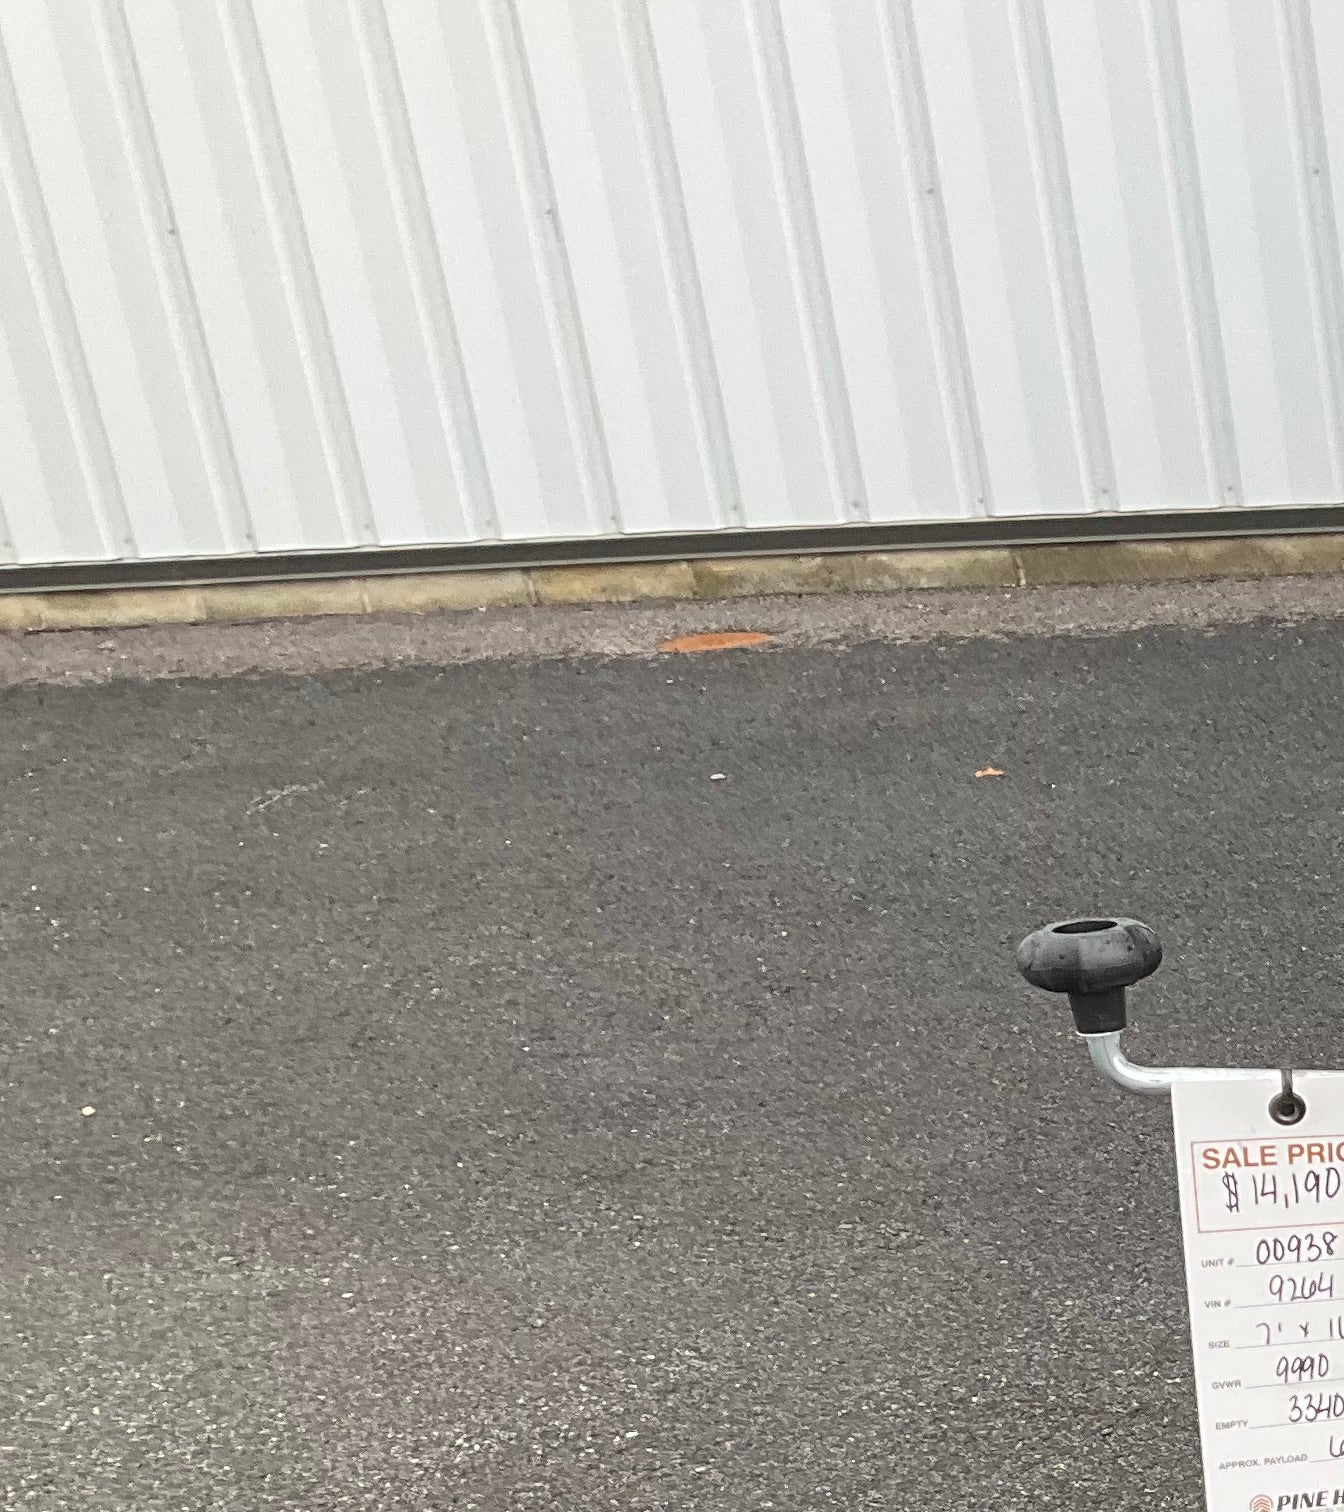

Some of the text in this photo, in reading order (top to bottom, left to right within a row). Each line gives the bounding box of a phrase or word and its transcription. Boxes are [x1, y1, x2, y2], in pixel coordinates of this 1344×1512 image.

[1202, 1145, 1278, 1169] SALE
[1201, 1231, 1338, 1268] UNIT # 00938
[1204, 1271, 1334, 1309] VIN # 9264
[1208, 1340, 1230, 1349] SIZE
[1211, 1352, 1329, 1390] GVWR 9990
[1215, 1392, 1344, 1431] EMPTY 3340
[1218, 1460, 1260, 1471] APPROX.
[1263, 1453, 1309, 1466] PAYLOAD
[1276, 1490, 1330, 1512] PINE
